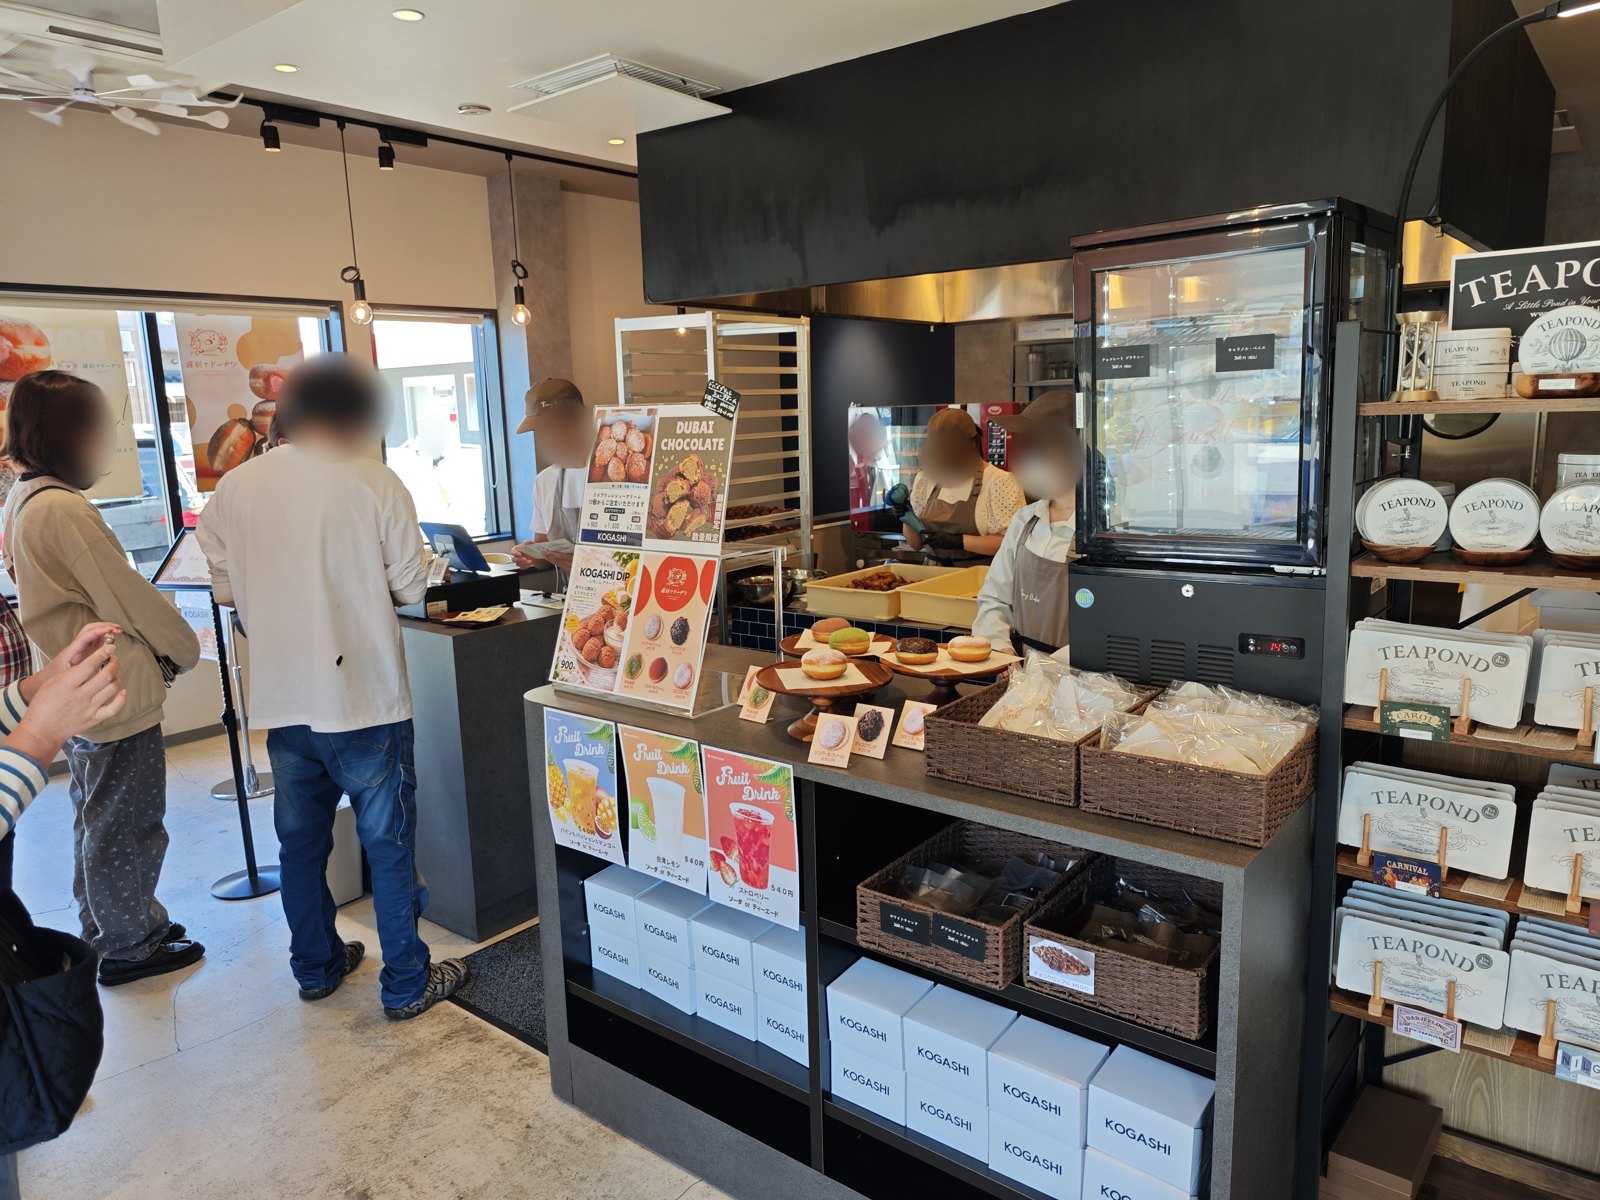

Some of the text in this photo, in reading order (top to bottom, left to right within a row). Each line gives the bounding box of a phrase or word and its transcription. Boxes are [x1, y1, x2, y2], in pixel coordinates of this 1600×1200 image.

[1515, 300, 1541, 310] Little
[1542, 298, 1568, 308] Pond
[1537, 316, 1600, 332] TEAPOND
[1444, 346, 1479, 354] TEAPOND
[1450, 380, 1487, 388] TEAPOND
[675, 420, 715, 434] DUBAI
[660, 437, 725, 451] CHOCOLATE
[1378, 496, 1436, 512] TEAPOND
[1461, 499, 1524, 514] TEAPOND
[597, 532, 627, 543] KOGASHI
[579, 567, 631, 582] KOGASHI DIP
[1269, 643, 1281, 652] 14
[1377, 644, 1491, 673] TEAPOND
[1396, 712, 1434, 724] CAROL
[554, 725, 581, 744] Fruit
[574, 742, 605, 757] Drink
[633, 743, 663, 762] Fruit
[656, 761, 690, 775] Drink
[716, 765, 751, 786] Fruit
[742, 785, 781, 801] Drink
[1370, 790, 1481, 824] TEAPOND
[1563, 827, 1600, 843] TE
[646, 863, 659, 873] ソーダ
[684, 855, 704, 869] 540円
[1386, 860, 1429, 876] CARNIVAL
[739, 884, 794, 901] ストロベリー 540円
[593, 902, 626, 921] KOGASHI
[728, 895, 743, 905] ソーダ
[752, 903, 779, 918] ティーエード
[643, 922, 678, 944] KOGASHI
[597, 945, 629, 966] KOGASHI
[701, 944, 740, 966] KOGASHI
[1367, 935, 1475, 973] TEAPOND
[648, 967, 680, 990] KOGASHI
[763, 968, 803, 992] KOGASHI
[705, 992, 742, 1016] KOGASHI
[766, 1016, 805, 1043] KOGASHI
[839, 1015, 887, 1043] KOGASHI
[1405, 1015, 1447, 1032] DARJEELING
[917, 1046, 970, 1076] KOGASHI
[842, 1067, 890, 1096] KOGASHI
[1003, 1082, 1062, 1116] KOGASHI
[920, 1100, 973, 1132] KOGASHI
[1105, 1117, 1172, 1156] KOGASHI
[1003, 1141, 1063, 1176] KOGASHI
